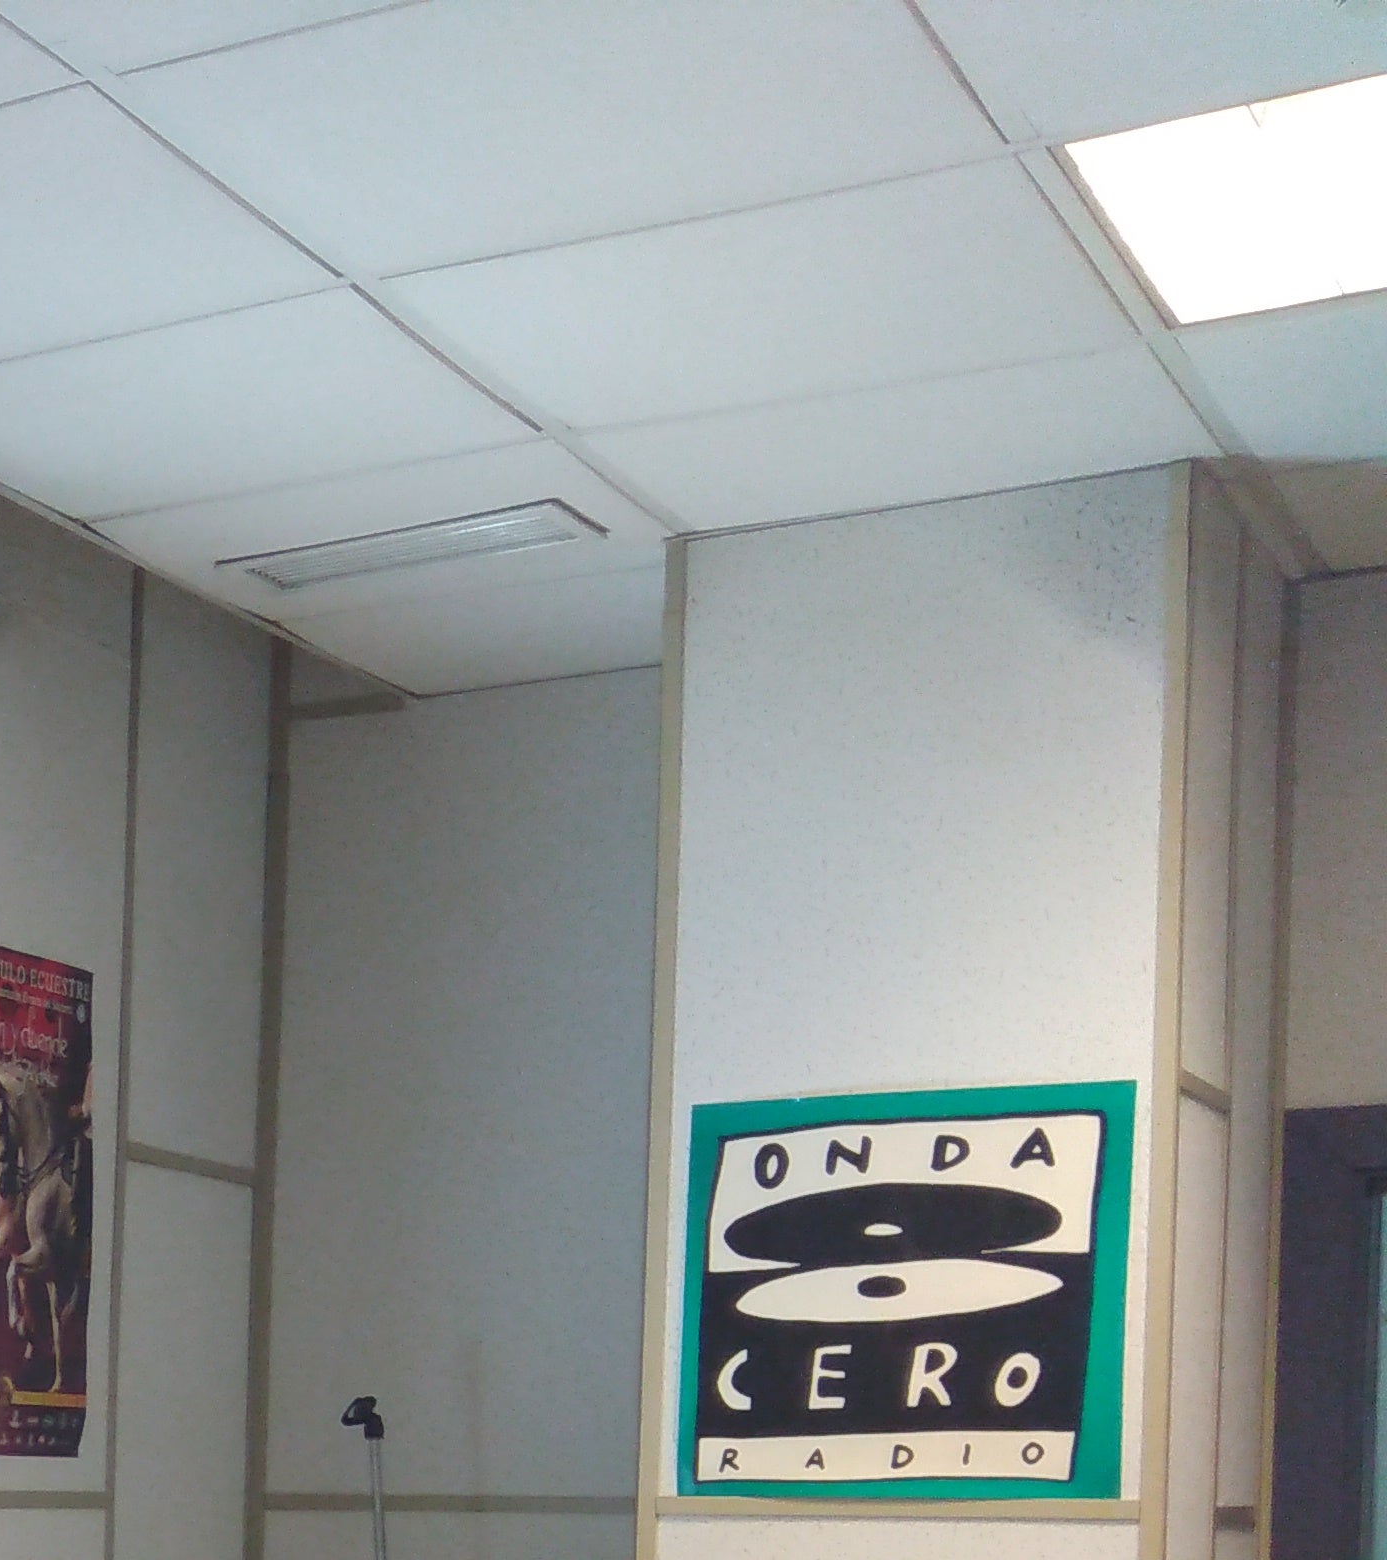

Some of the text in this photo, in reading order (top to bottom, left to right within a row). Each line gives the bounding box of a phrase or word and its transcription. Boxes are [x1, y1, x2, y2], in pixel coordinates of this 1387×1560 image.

[30, 967, 90, 1002] ECUESTRE
[754, 1127, 1056, 1190] ONDA
[717, 1341, 1041, 1411] CERO
[718, 1441, 1045, 1473] RADIO
